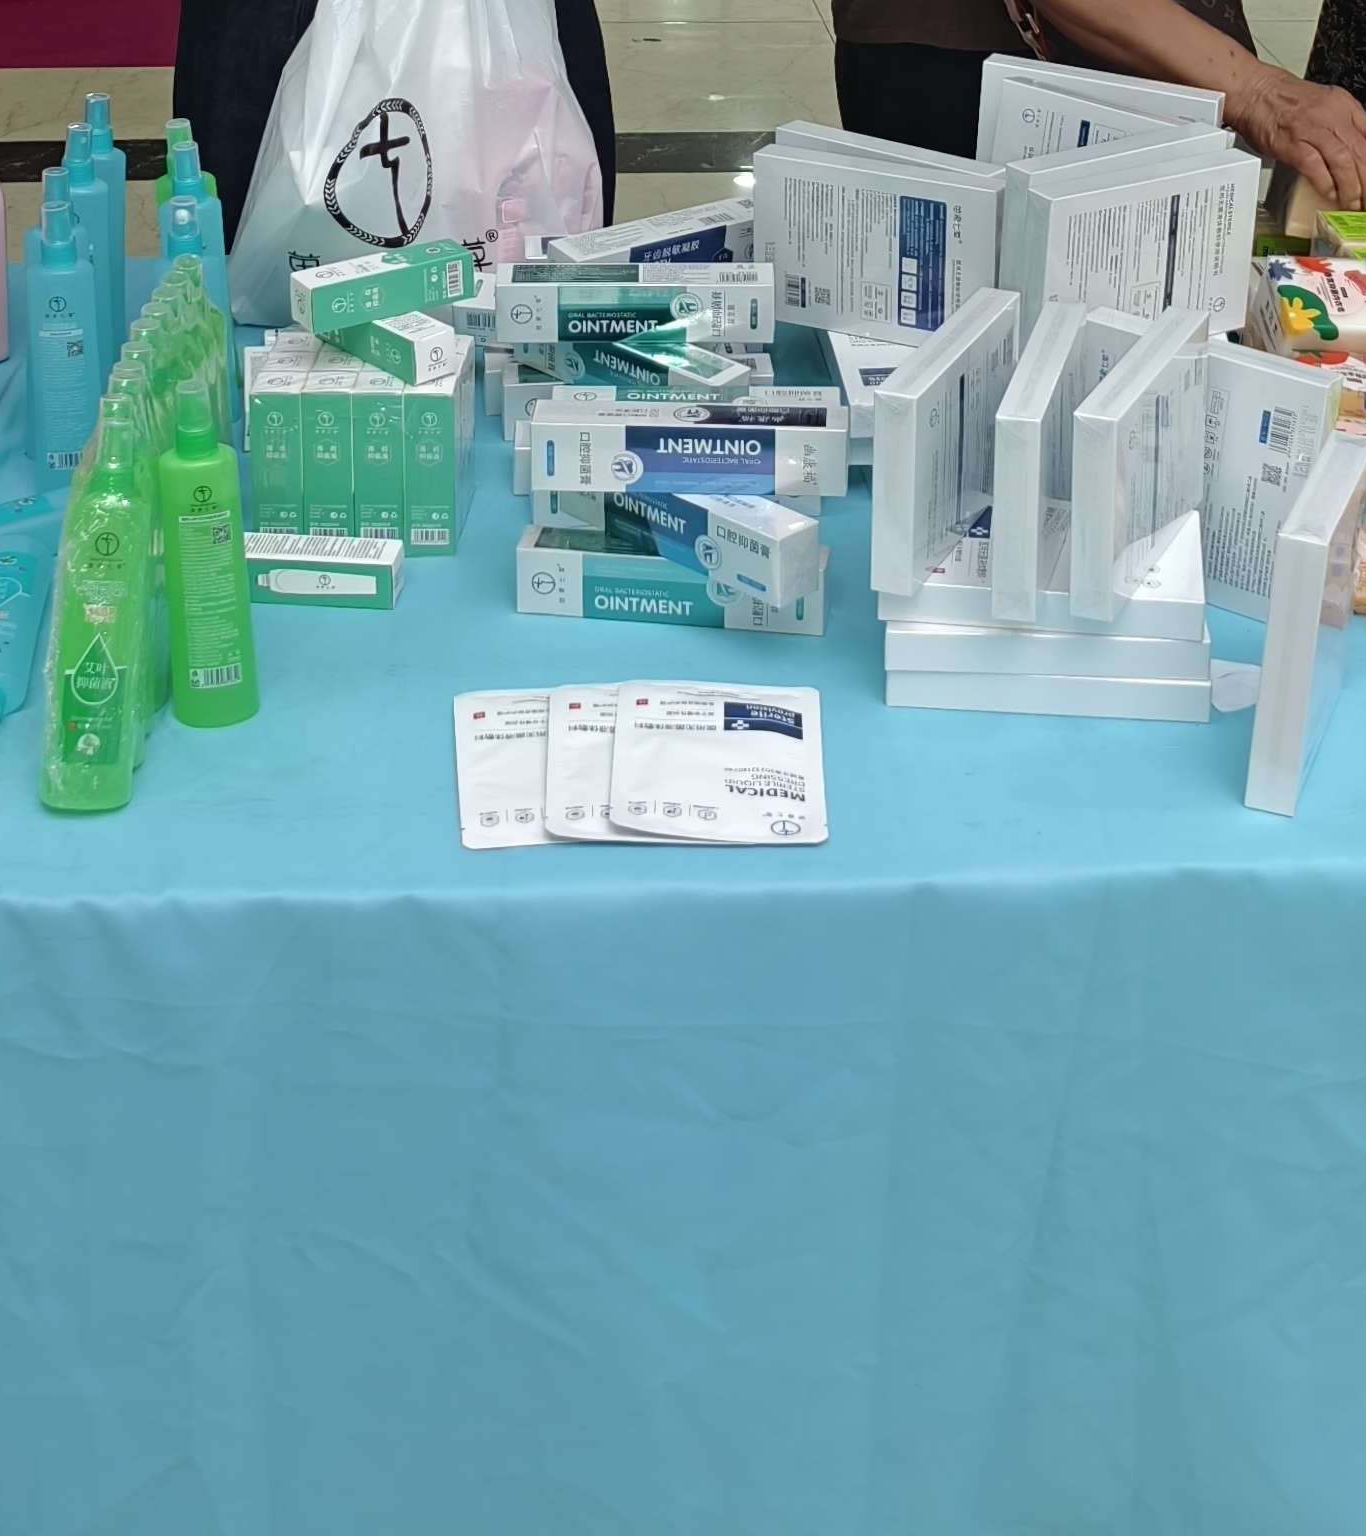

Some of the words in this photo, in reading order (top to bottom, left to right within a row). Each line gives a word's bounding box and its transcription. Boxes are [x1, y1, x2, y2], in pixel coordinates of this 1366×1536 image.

[643, 240, 701, 261] 牙齿脱敏凝胶
[568, 319, 659, 334] OINTMENT
[593, 348, 662, 385] OINTMENT
[627, 392, 720, 402] OINTMENT
[656, 437, 761, 455] OINTMENT
[613, 492, 687, 534] OINTMENT
[716, 525, 772, 560] 口腔抑菌膏
[594, 596, 693, 616] OINTMENT
[751, 773, 806, 786] DRESSING
[724, 783, 806, 803] MEDICAL
